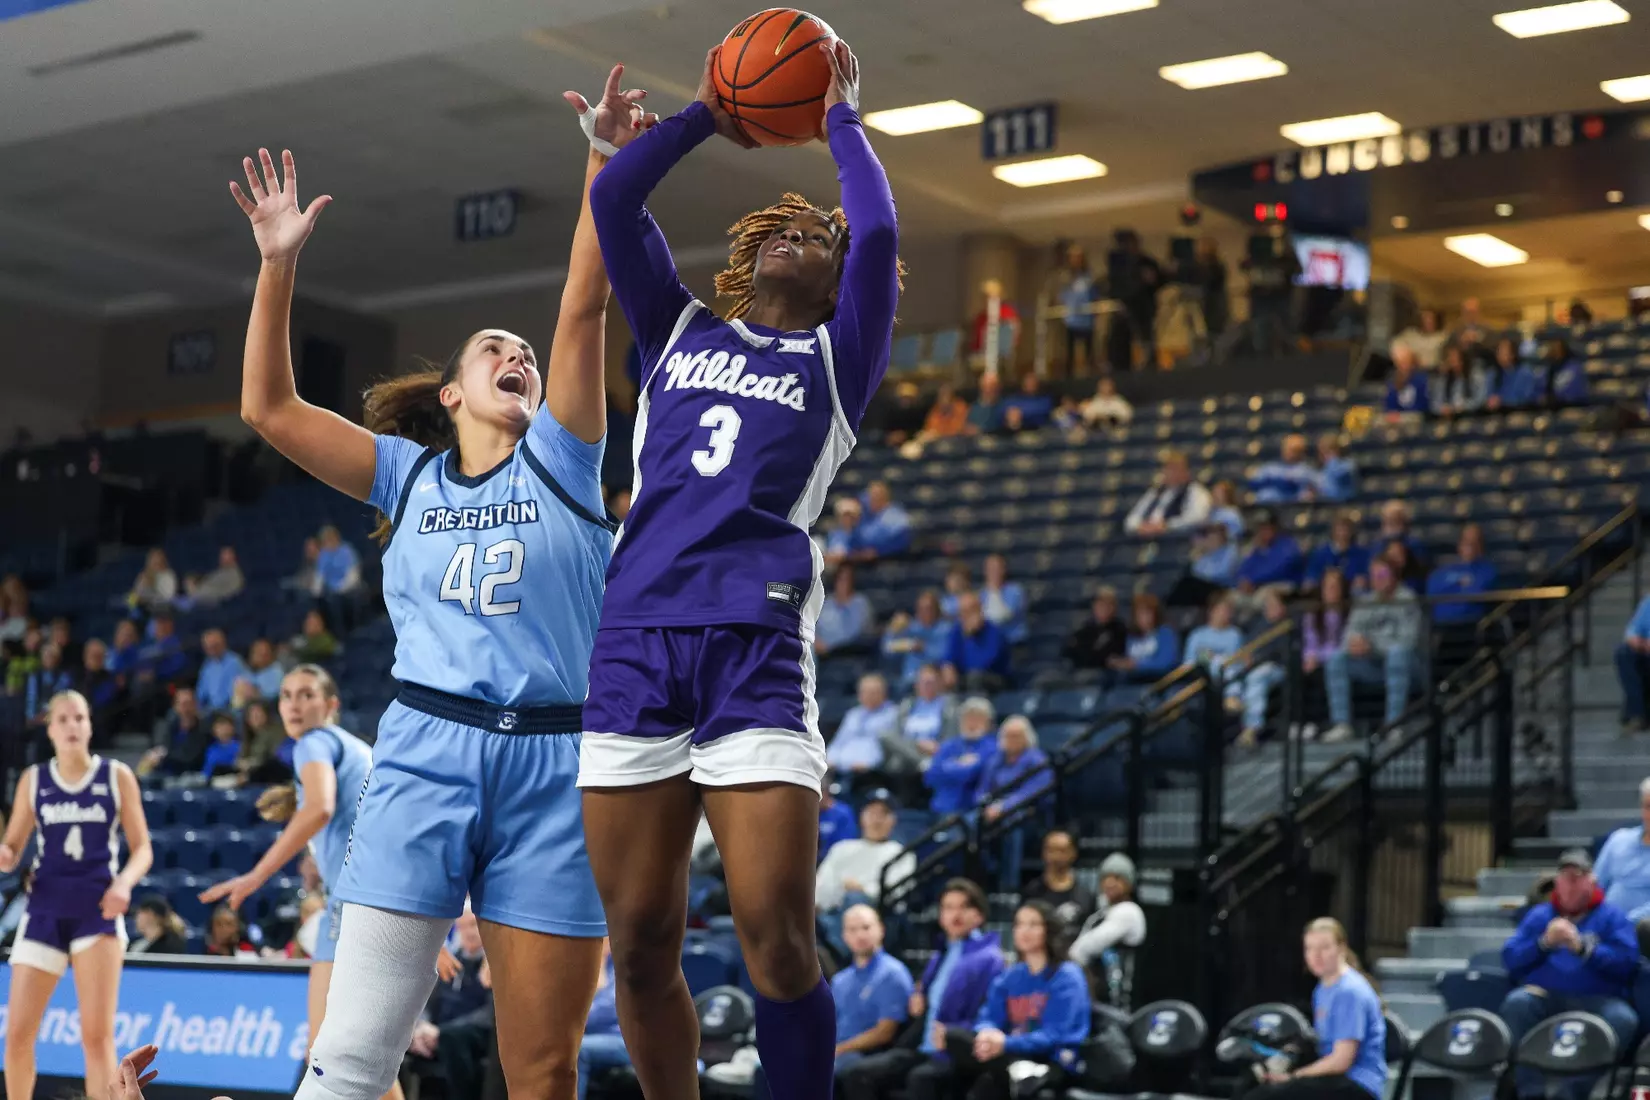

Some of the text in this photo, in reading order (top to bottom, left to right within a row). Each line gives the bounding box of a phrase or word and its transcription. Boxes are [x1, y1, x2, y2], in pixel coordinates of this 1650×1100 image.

[664, 349, 806, 412] Wildcats
[690, 404, 742, 477] 3
[438, 538, 526, 617] 42
[63, 824, 84, 861] 4
[151, 1002, 283, 1058] health
